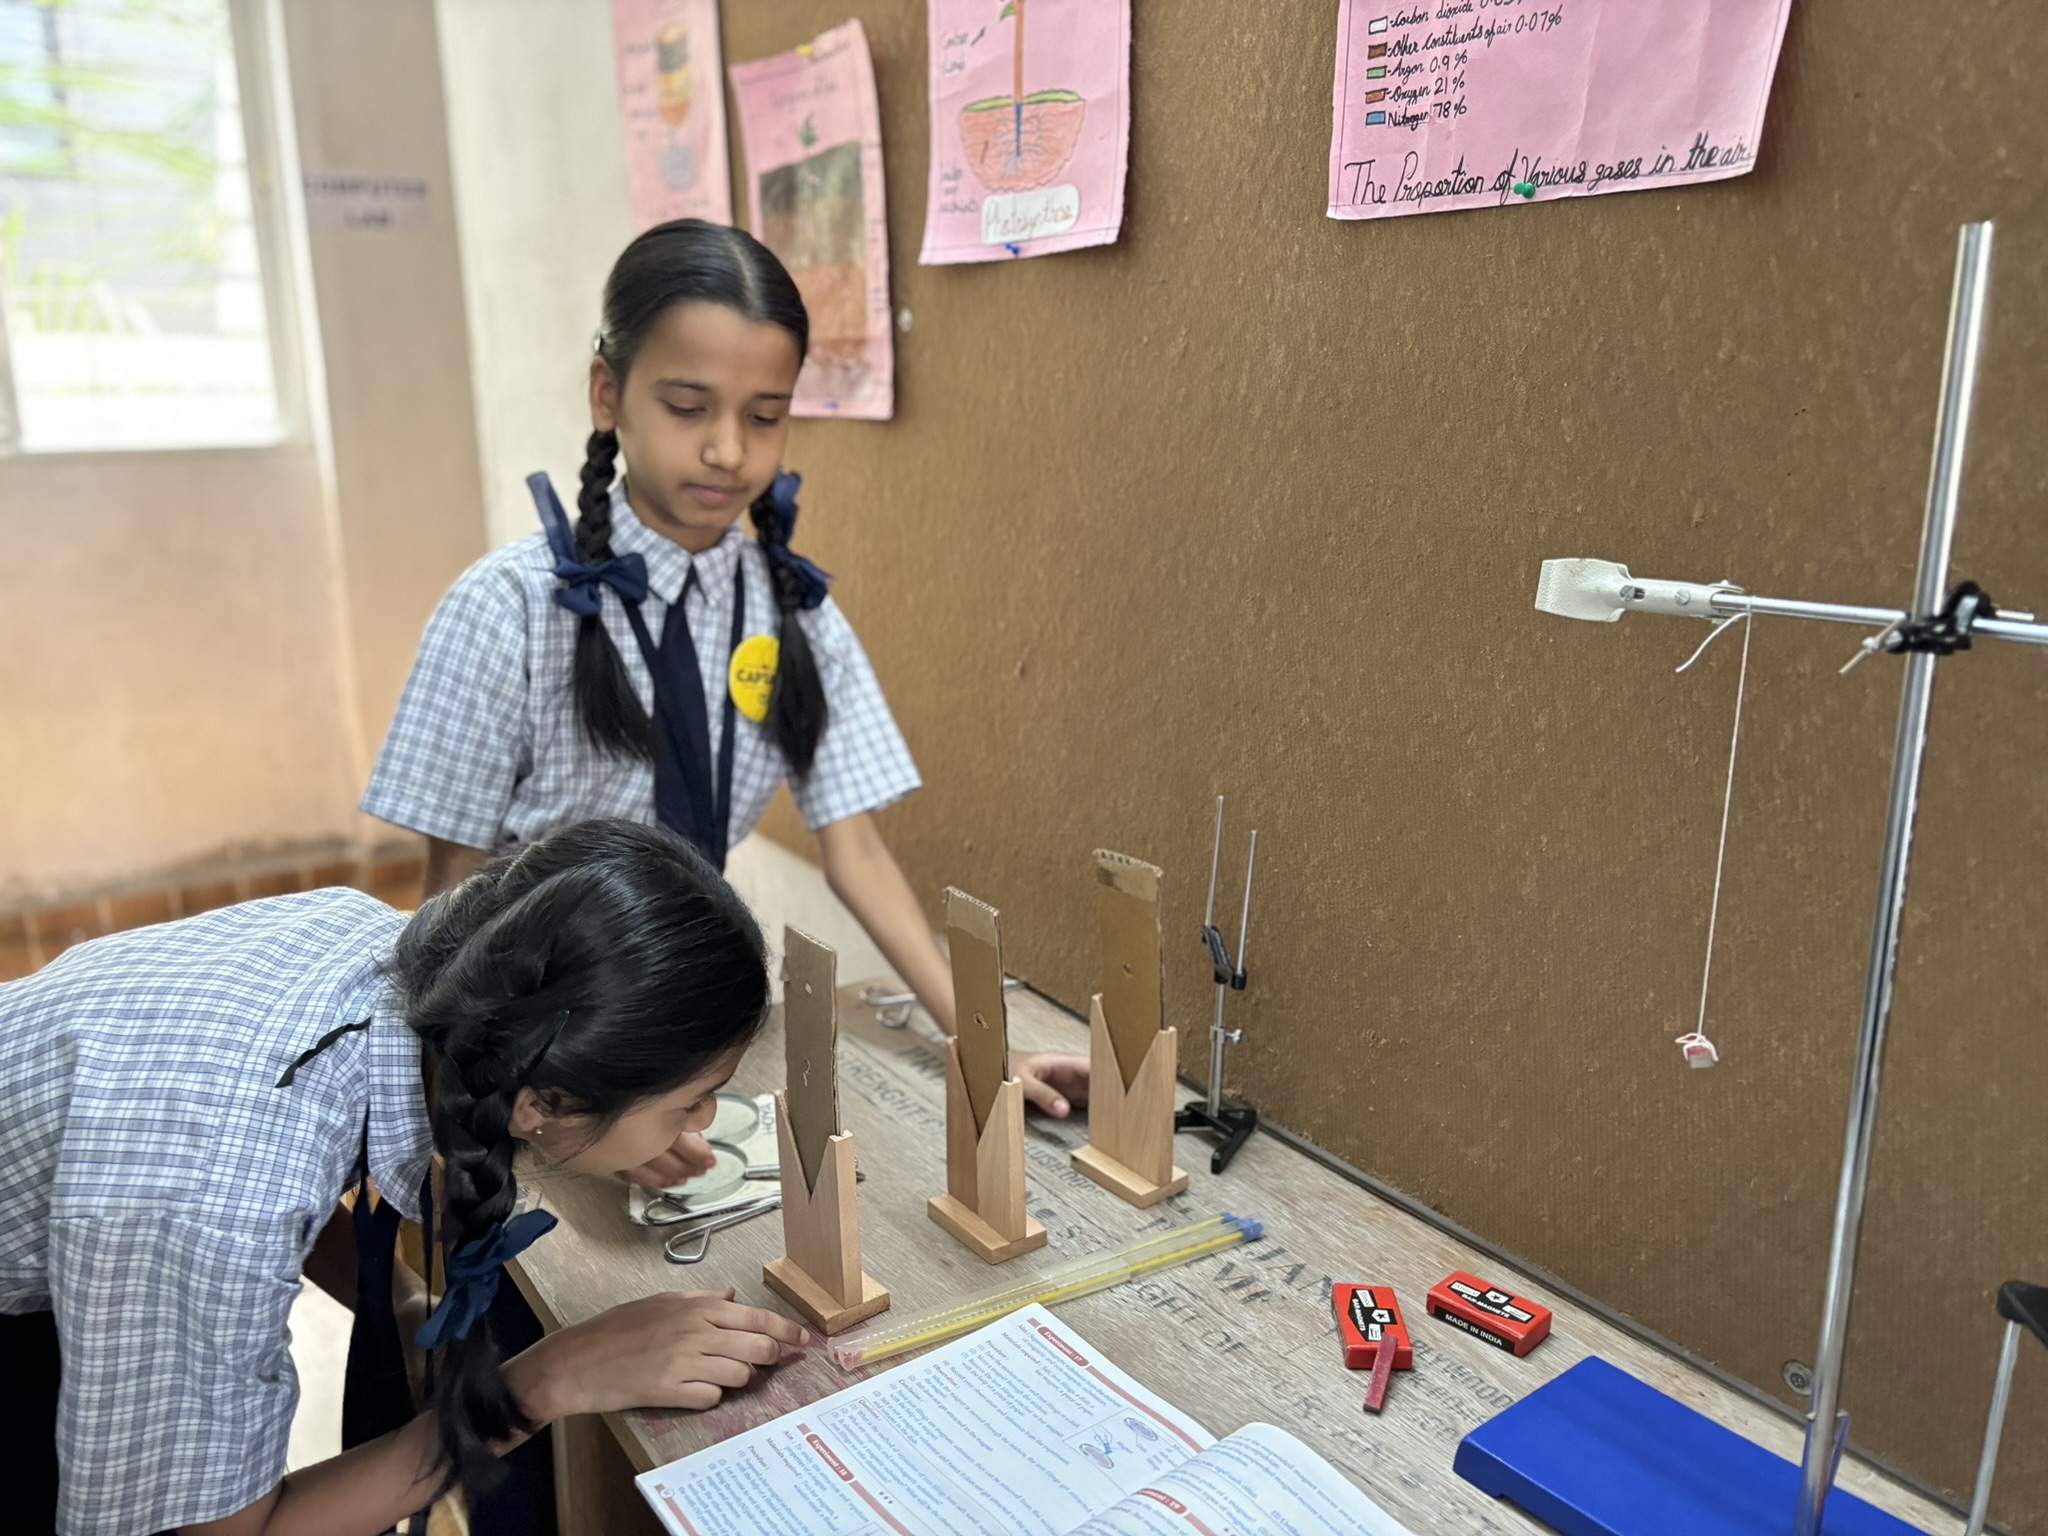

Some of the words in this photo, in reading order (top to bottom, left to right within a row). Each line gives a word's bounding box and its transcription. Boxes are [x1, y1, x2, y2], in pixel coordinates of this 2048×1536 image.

[1344, 158, 1387, 205] The
[1393, 151, 1485, 207] Proportion
[1488, 148, 1519, 205] of
[1522, 155, 1587, 188] Various
[1587, 157, 1643, 193] gases
[1648, 144, 1676, 175] in
[1681, 131, 1718, 171] the
[1461, 1293, 1510, 1318] BAR-MAGNETS
[1043, 1331, 1074, 1354] Experiment
[1445, 1313, 1468, 1330] MADE
[1470, 1324, 1479, 1334] IN
[1480, 1330, 1502, 1346] INDIA
[811, 1439, 841, 1467] Experiment
